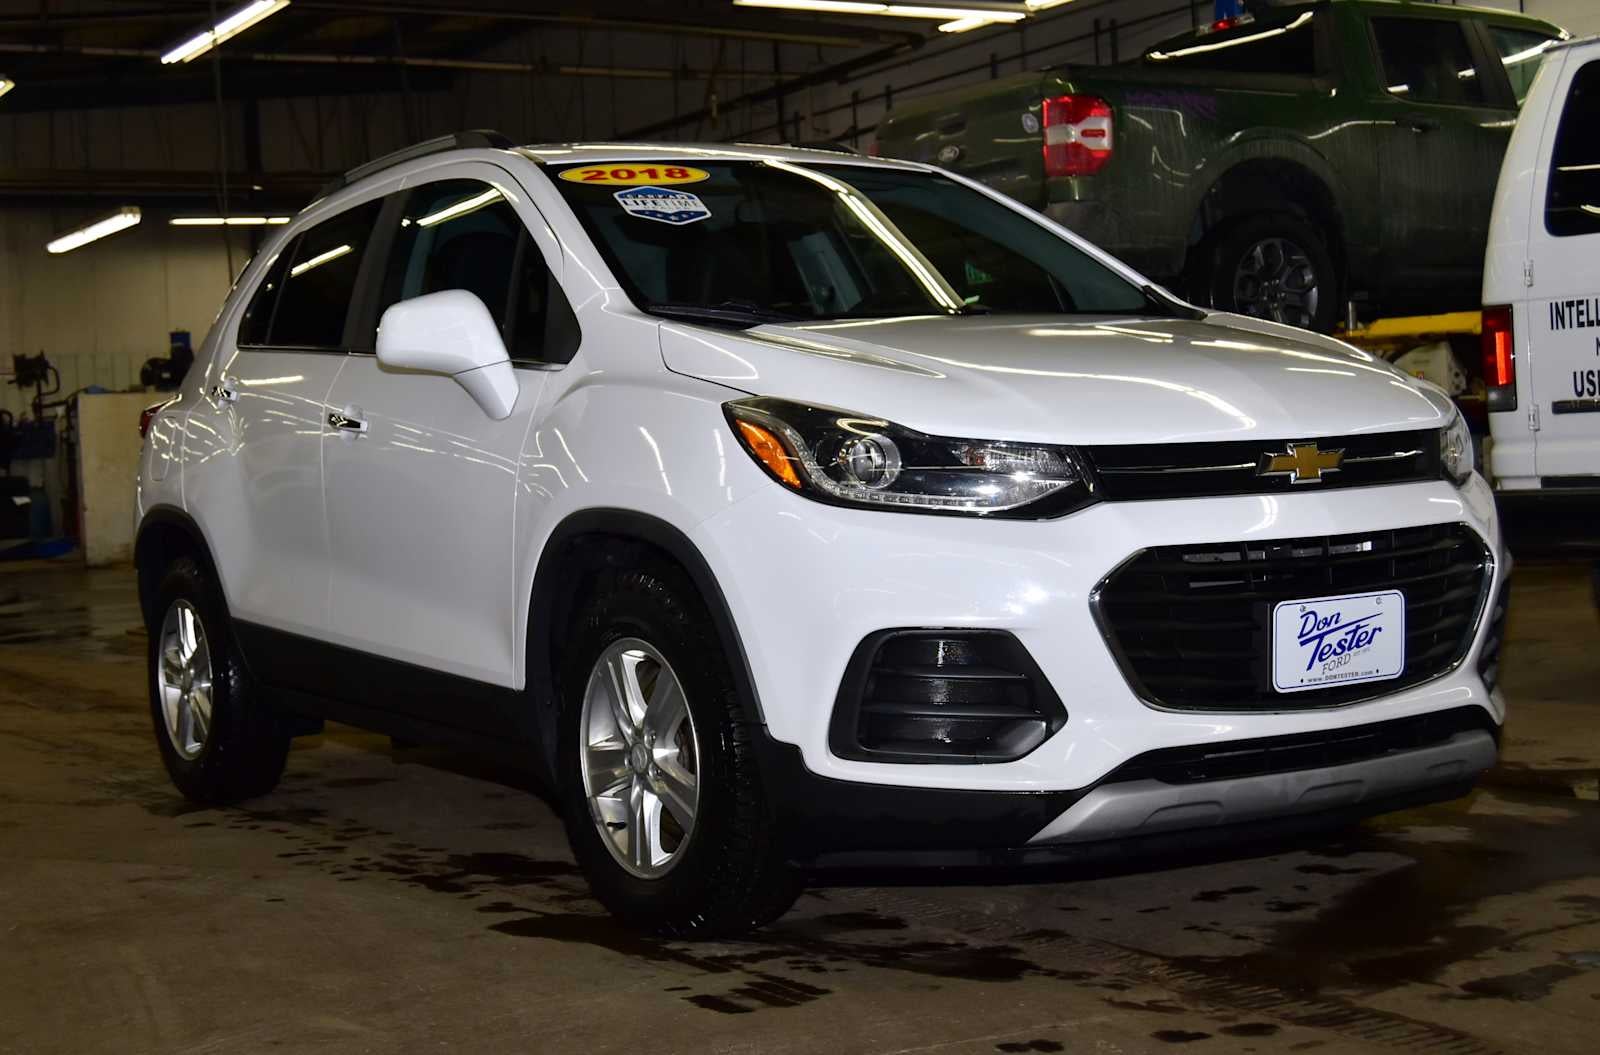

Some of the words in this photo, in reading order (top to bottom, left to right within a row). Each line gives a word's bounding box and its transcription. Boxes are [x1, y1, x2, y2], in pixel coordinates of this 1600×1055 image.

[581, 168, 690, 181] 2018
[1573, 370, 1600, 398] US
[1297, 610, 1341, 640] Don
[1299, 612, 1383, 672] Tester
[1322, 653, 1351, 675] FORD
